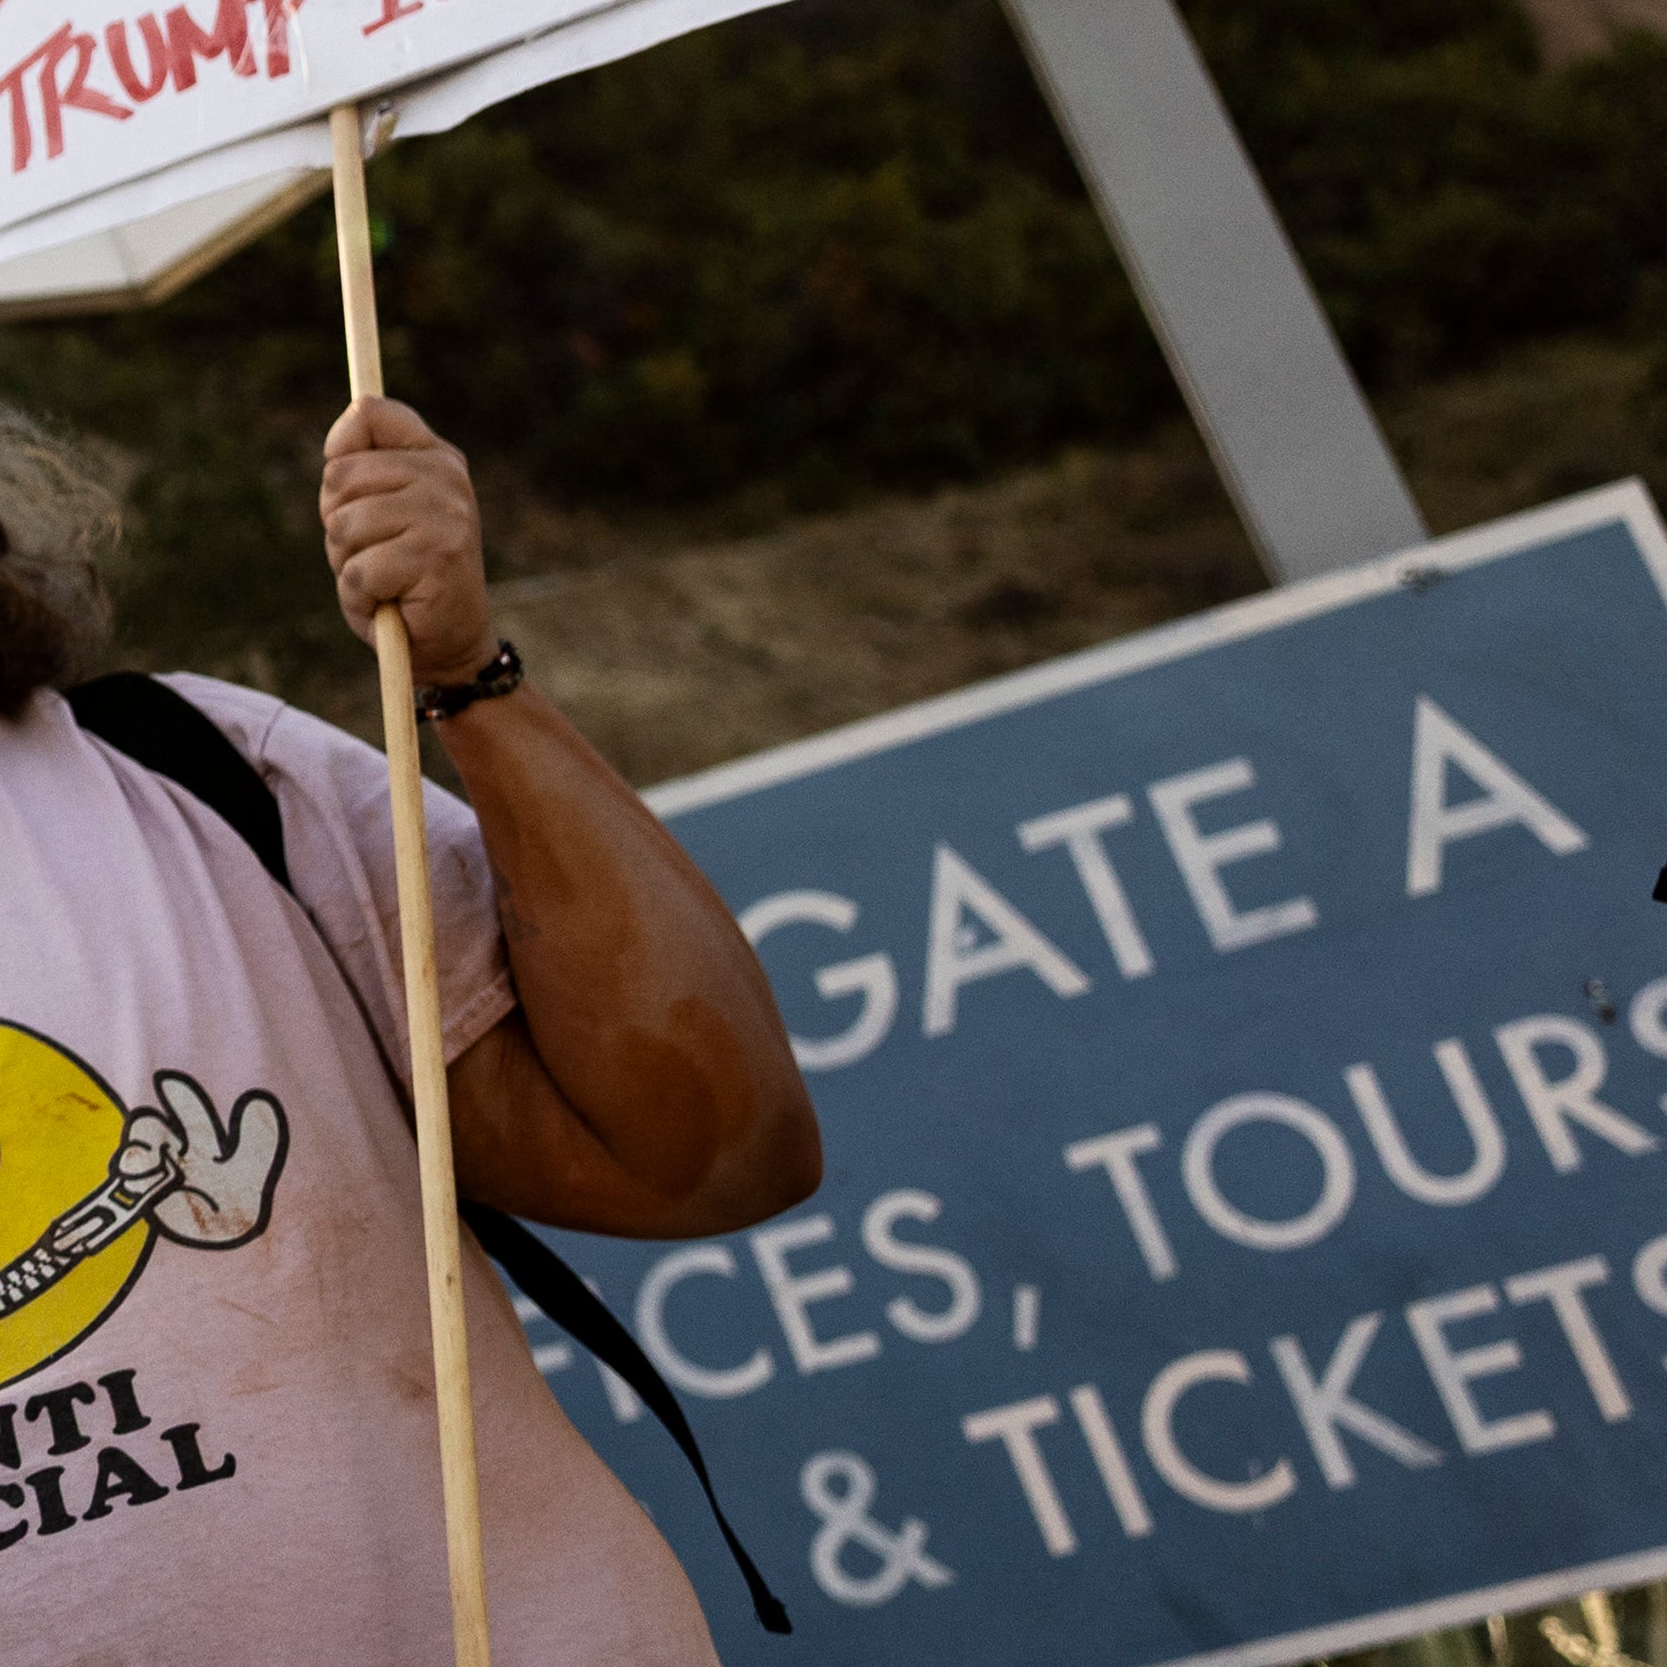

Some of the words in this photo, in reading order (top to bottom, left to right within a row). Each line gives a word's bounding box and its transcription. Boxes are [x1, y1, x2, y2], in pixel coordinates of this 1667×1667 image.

[737, 757, 1318, 1072] GATE
[1404, 693, 1590, 898] A
[800, 1450, 954, 1607] &
